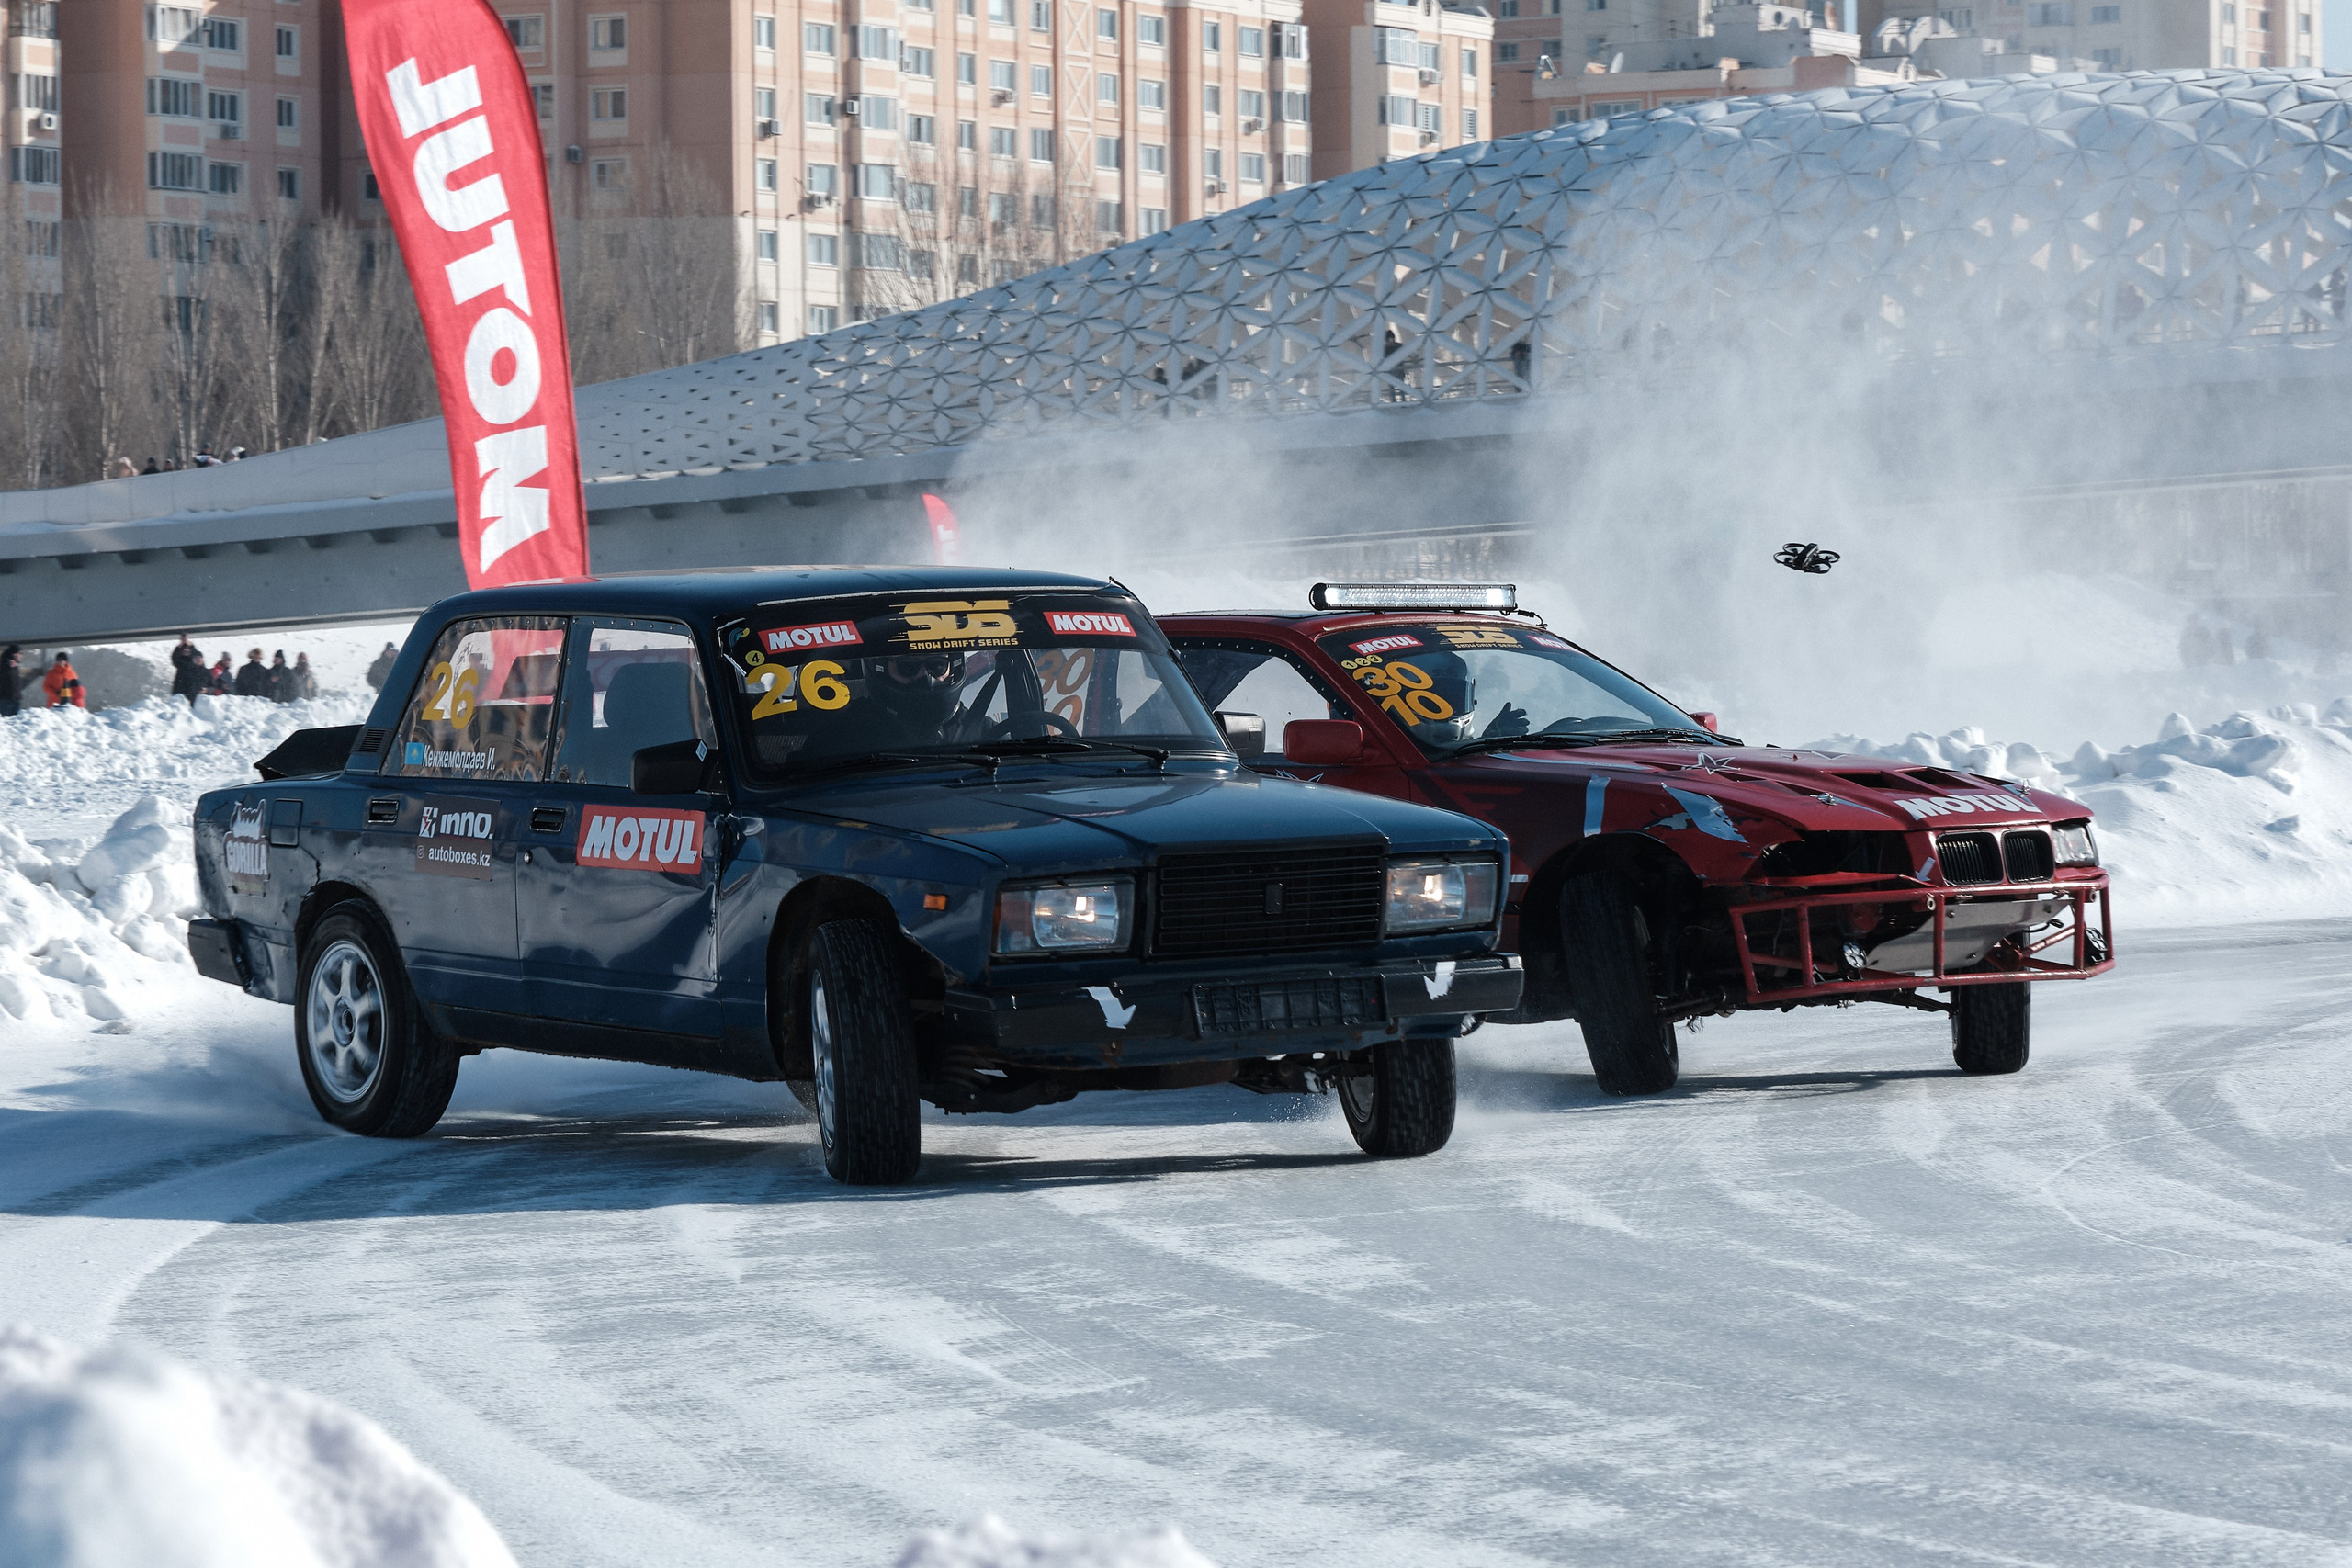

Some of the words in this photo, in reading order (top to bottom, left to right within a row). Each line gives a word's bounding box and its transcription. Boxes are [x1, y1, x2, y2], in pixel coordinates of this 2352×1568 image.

[768, 625, 856, 650] MOTUL
[1053, 615, 1130, 633] MOTUL
[910, 642, 942, 650] SNOW
[978, 638, 1018, 647] SERIES
[1356, 636, 1419, 653] MOTUL
[751, 653, 760, 663] 4
[746, 660, 851, 721] 26
[1352, 661, 1433, 697] 30
[422, 661, 479, 730] 26
[1380, 690, 1453, 727] 10
[423, 745, 486, 773] Кенжемолдаев
[486, 747, 496, 771] И.
[1893, 794, 2042, 821] MOTUL
[582, 815, 697, 864] MOTUL
[428, 846, 491, 867] autoboxes.kz
